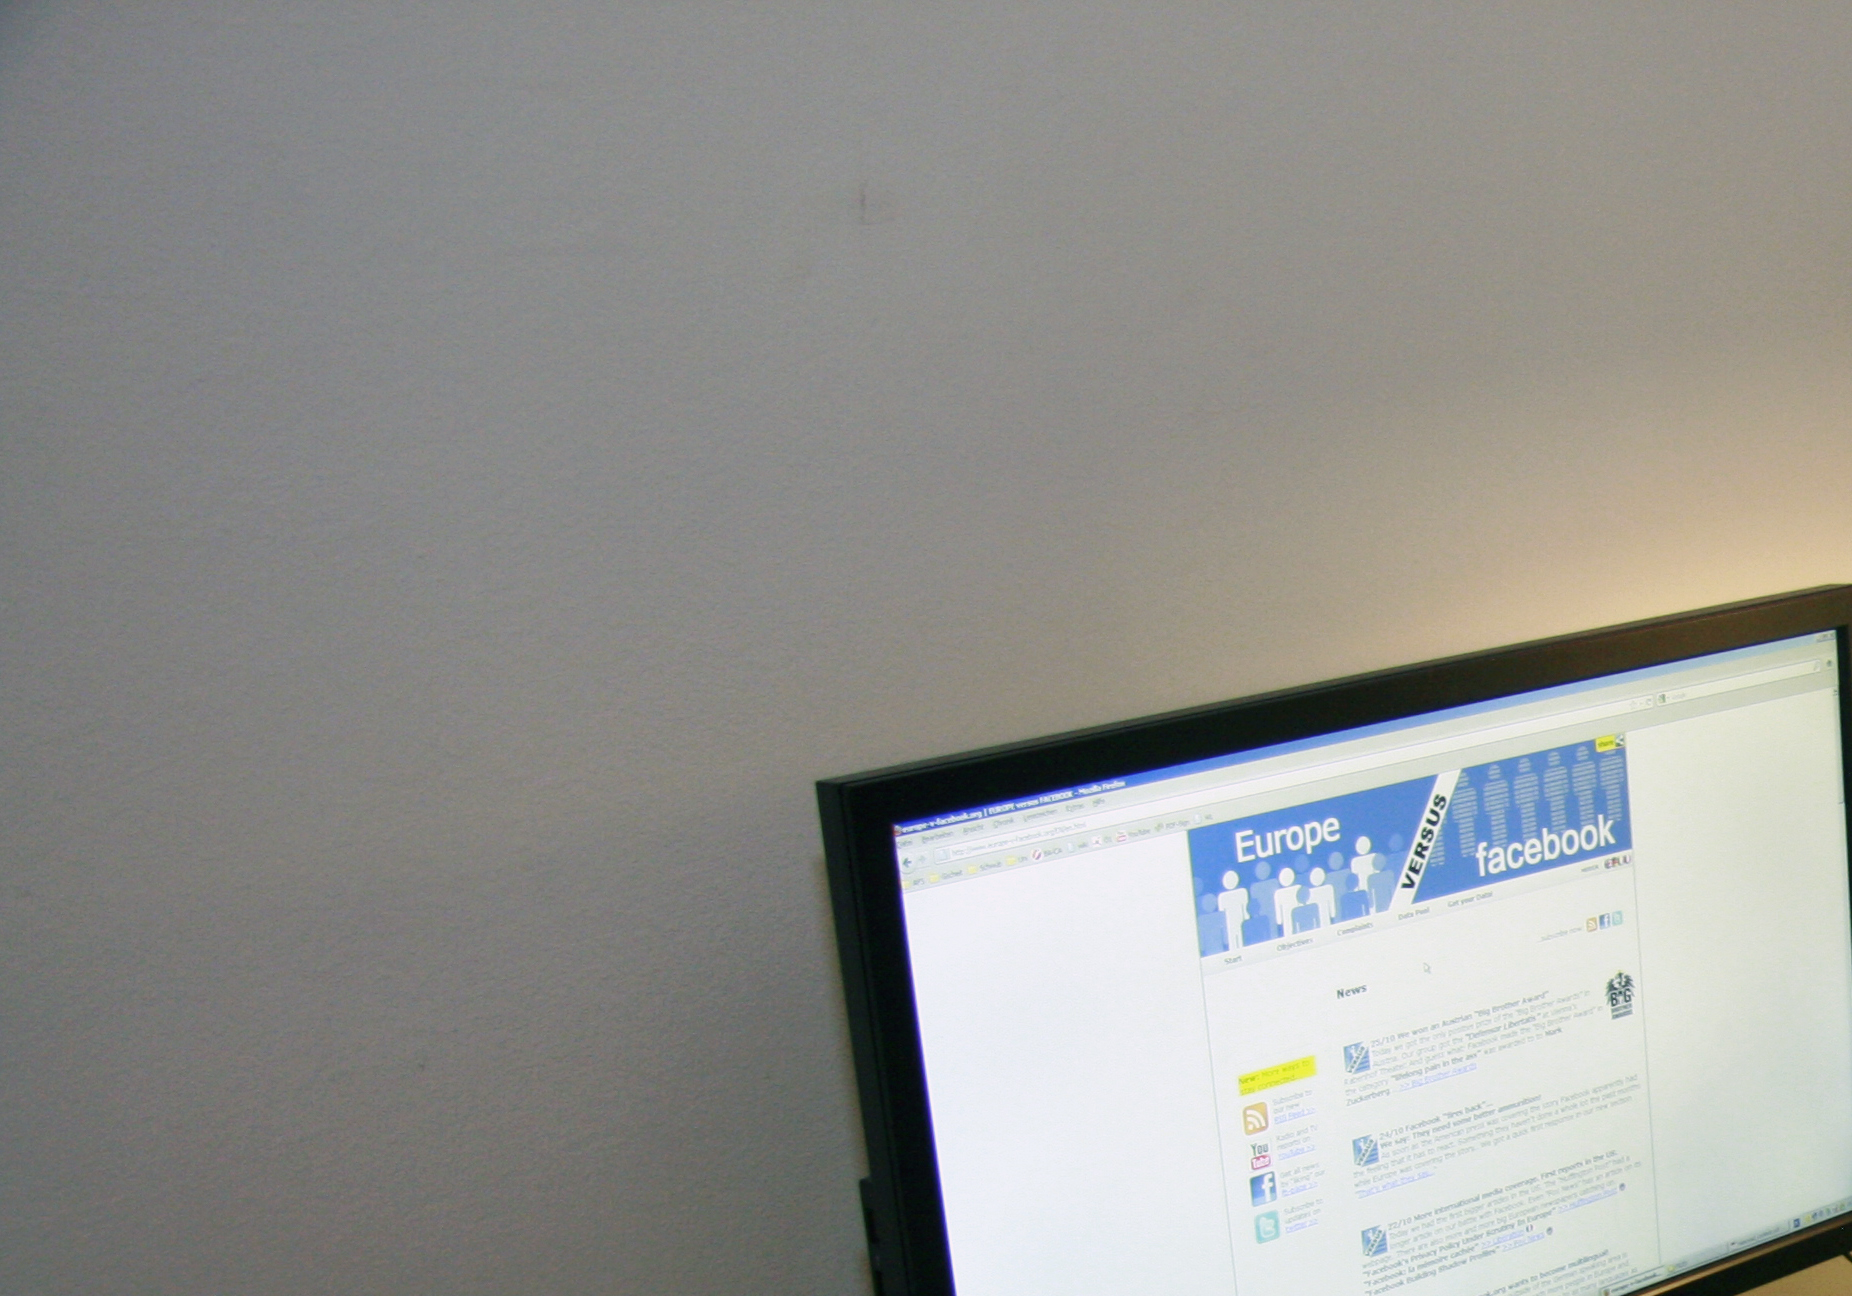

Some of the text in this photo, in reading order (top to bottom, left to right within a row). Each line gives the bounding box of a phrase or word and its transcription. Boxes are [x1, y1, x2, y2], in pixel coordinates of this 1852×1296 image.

[1235, 817, 1341, 863] Europe
[1401, 794, 1447, 890] VERSUS
[1476, 814, 1616, 877] facebook
[1224, 954, 1242, 964] Start
[1276, 936, 1313, 952] Objectives
[1336, 920, 1373, 937] Complaints
[1335, 982, 1367, 999] News
[1250, 1143, 1269, 1157] You
